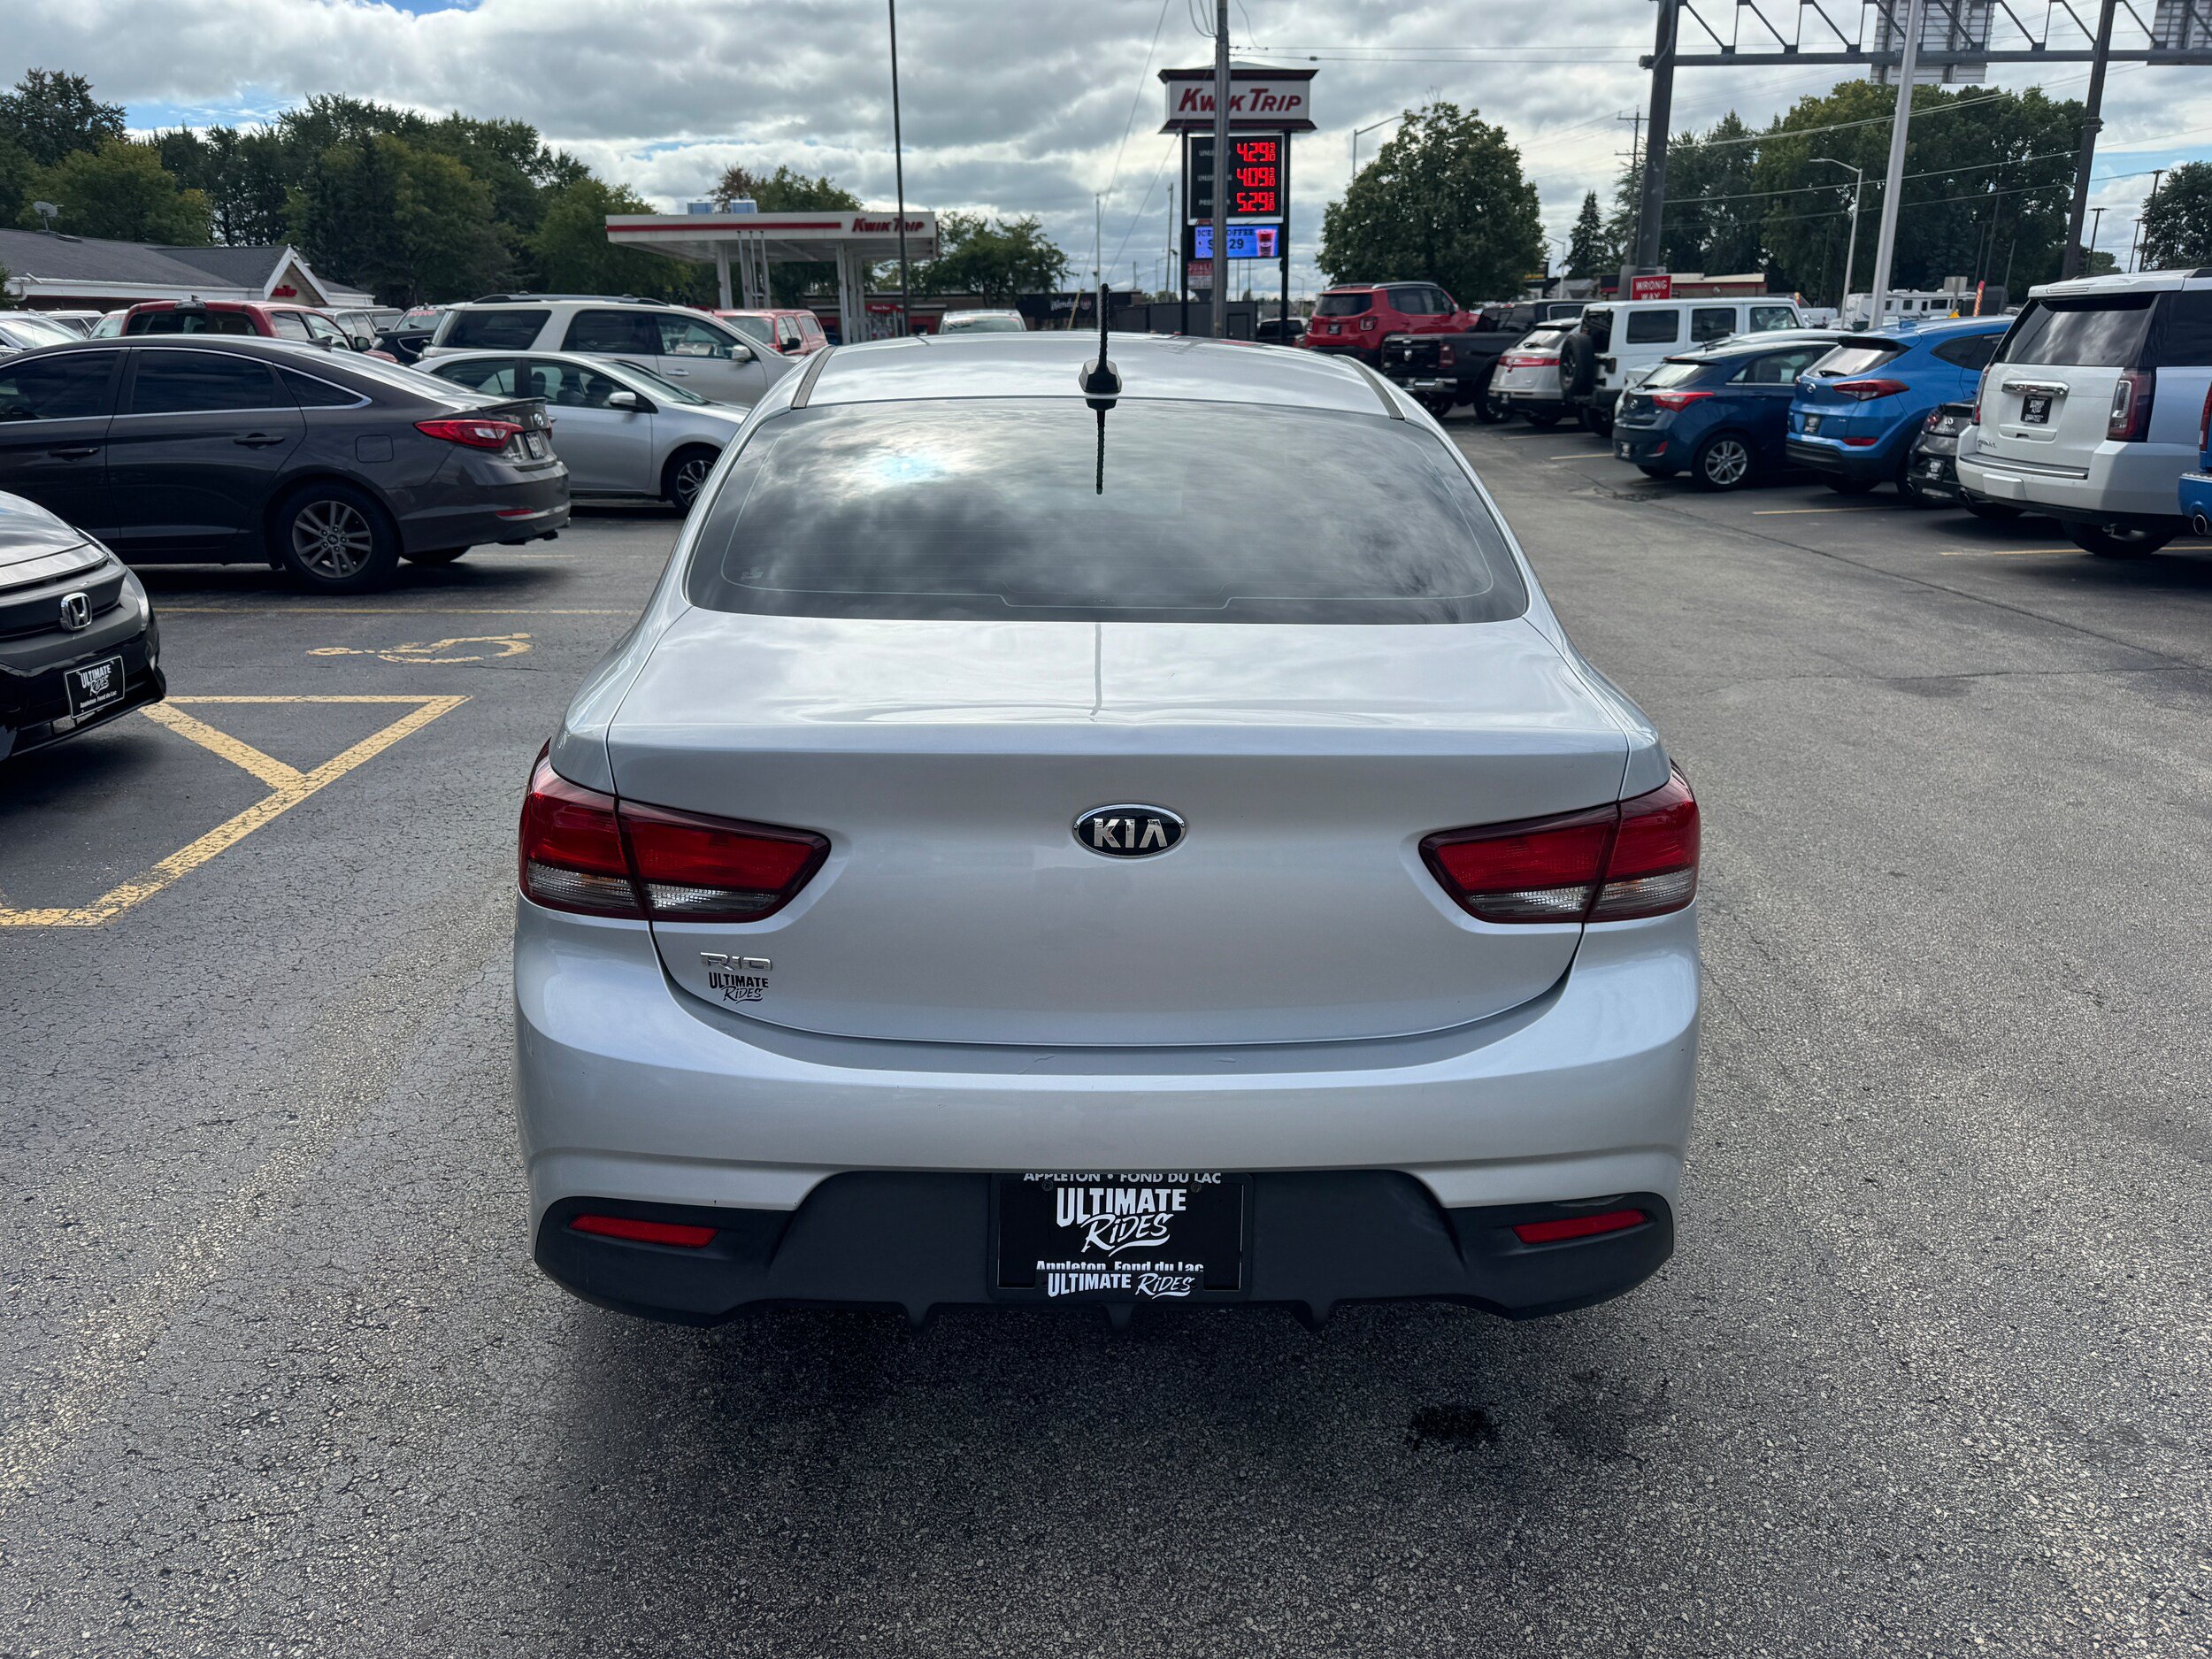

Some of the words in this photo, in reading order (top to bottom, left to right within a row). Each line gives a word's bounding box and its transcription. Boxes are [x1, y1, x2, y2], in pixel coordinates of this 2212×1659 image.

[1179, 88, 1246, 111] KWK
[1248, 88, 1302, 111] TRIP
[852, 218, 891, 232] KWIK
[1225, 228, 1254, 237] OFFEE
[1636, 280, 1667, 291] WRONG
[80, 664, 111, 688] ULTIMATE
[1094, 818, 1168, 849] KIA
[701, 952, 772, 971] RIO
[709, 972, 769, 988] ULTIMATE
[1023, 1173, 1101, 1182] APPLETON
[1120, 1173, 1164, 1183] FOND
[1168, 1173, 1189, 1183] DU
[1194, 1173, 1222, 1184] LAC
[1056, 1187, 1187, 1227] ULTIMATE
[1048, 1273, 1132, 1298] ULTIMATE
